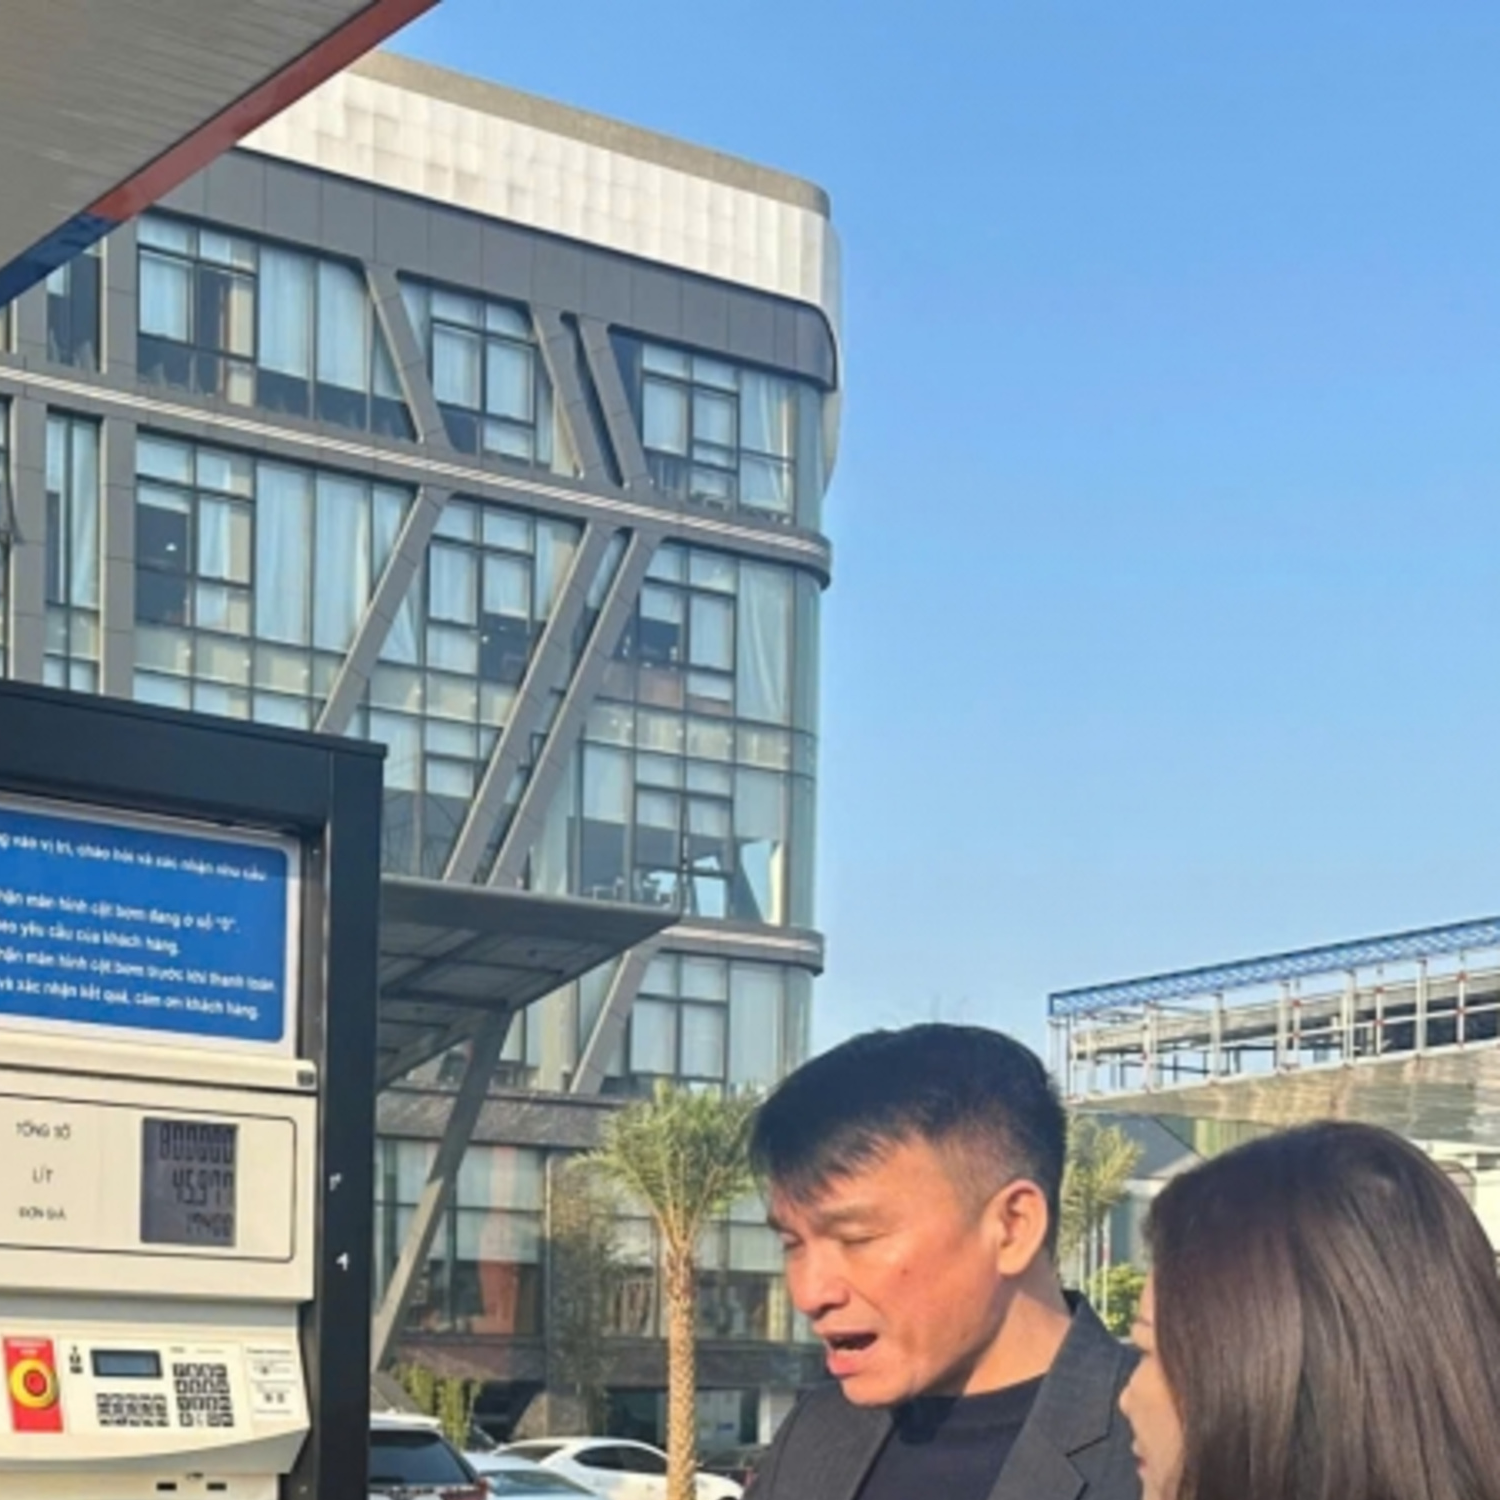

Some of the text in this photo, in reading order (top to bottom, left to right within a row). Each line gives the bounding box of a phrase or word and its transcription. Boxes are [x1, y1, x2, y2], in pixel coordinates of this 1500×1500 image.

[180, 856, 214, 875] nhận
[26, 892, 55, 909] màn
[59, 896, 87, 913] hình
[19, 920, 44, 938] yêu
[49, 920, 74, 941] cầu
[103, 929, 142, 948] khách
[26, 950, 55, 968] màn
[59, 953, 88, 970] hình
[16, 976, 40, 994] xác
[43, 980, 77, 1000] nhận
[186, 996, 224, 1014] khách
